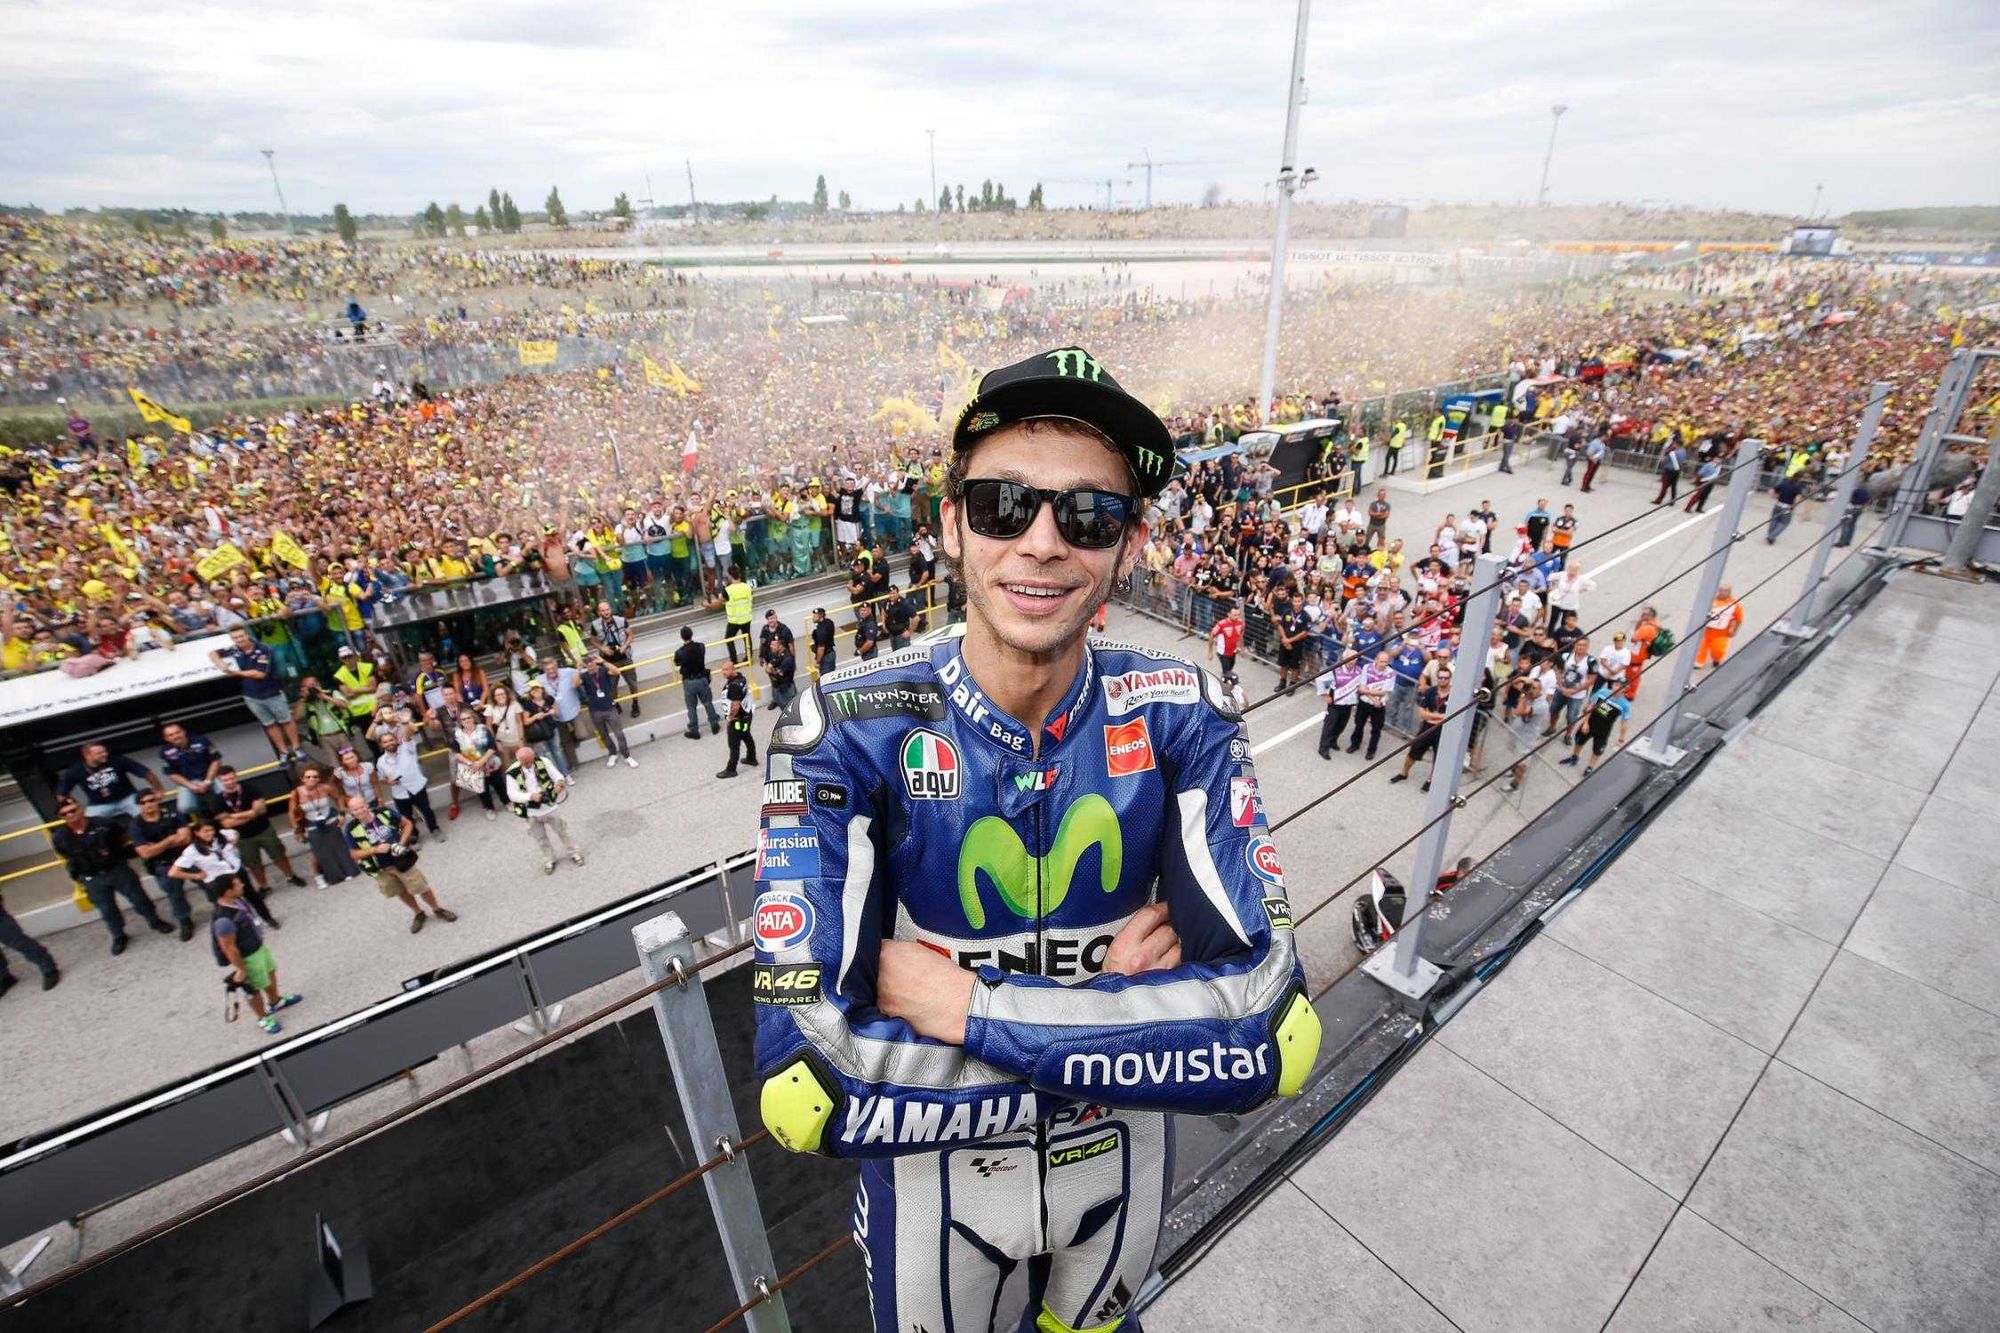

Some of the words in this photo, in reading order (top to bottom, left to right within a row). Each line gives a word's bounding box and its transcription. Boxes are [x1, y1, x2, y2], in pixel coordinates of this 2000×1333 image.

[1122, 669, 1197, 693] YAMAHA
[858, 688, 941, 704] MONSTER
[989, 721, 1026, 751] Bag
[1109, 737, 1147, 756] ENEOS
[912, 770, 955, 798] agv
[758, 910, 795, 931] PATA
[772, 995, 819, 1004] APPAREL
[1063, 1041, 1268, 1086] movistar
[840, 1092, 1037, 1145] YAMAHA
